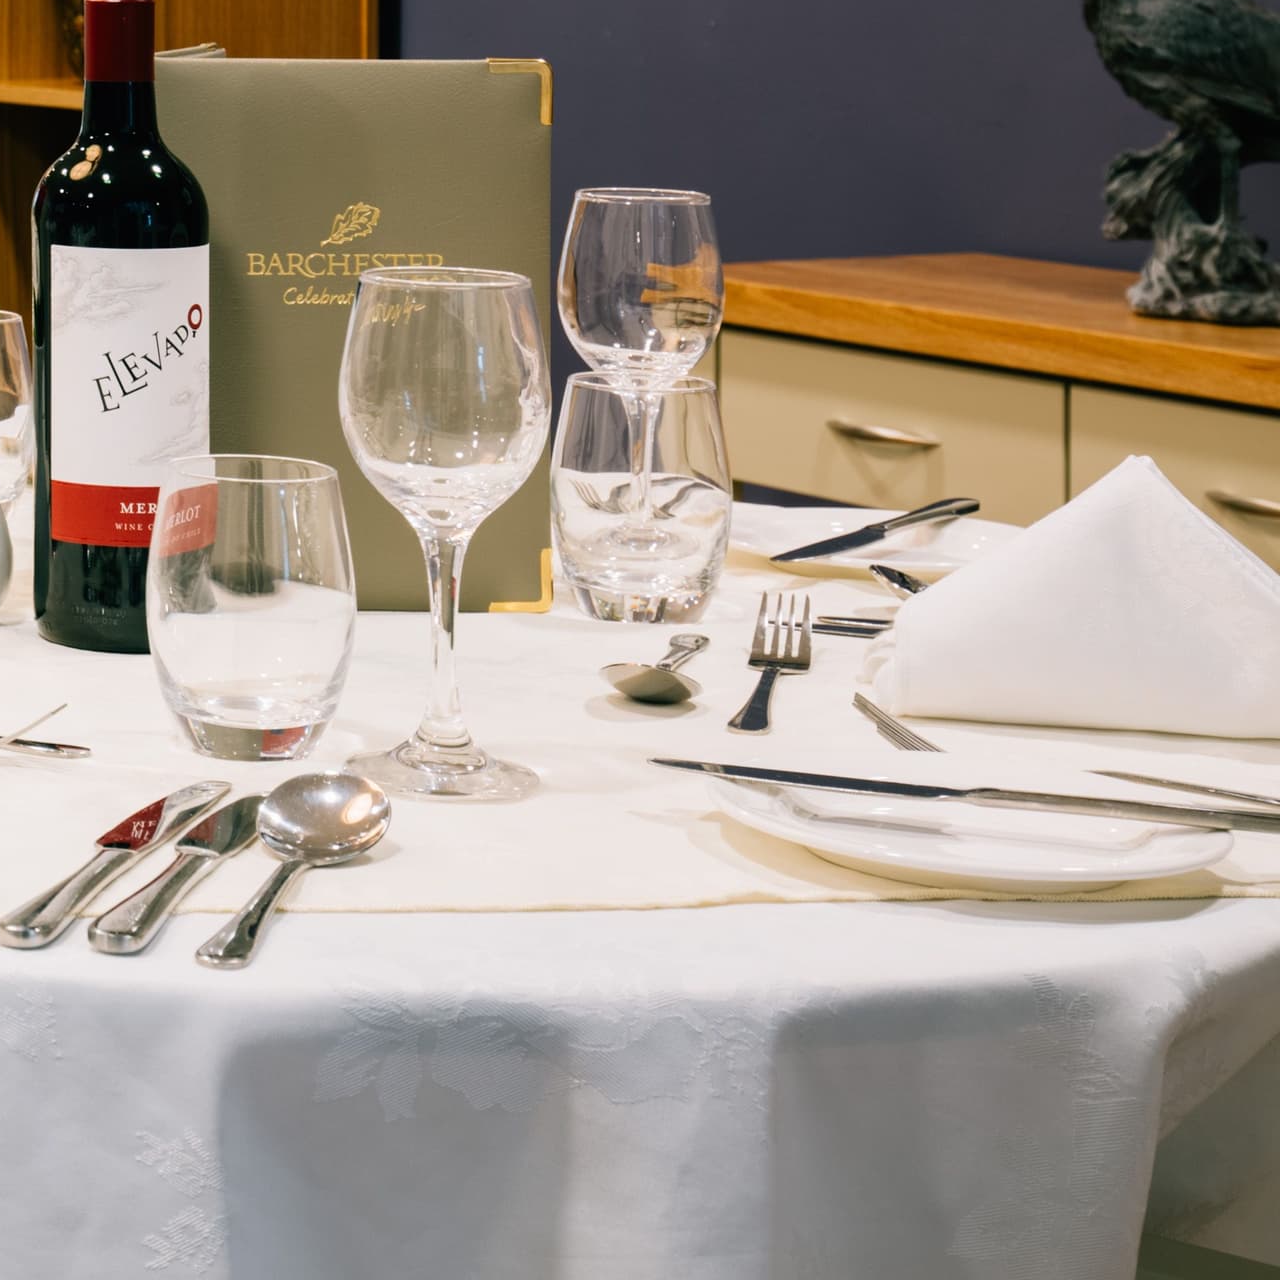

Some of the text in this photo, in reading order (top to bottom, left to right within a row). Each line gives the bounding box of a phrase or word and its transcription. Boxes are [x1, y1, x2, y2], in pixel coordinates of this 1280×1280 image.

[246, 252, 444, 278] BARCHESTER
[283, 286, 355, 305] Celebrat
[92, 303, 203, 413] ELEVADO
[120, 502, 157, 515] MER
[114, 522, 144, 531] WINE
